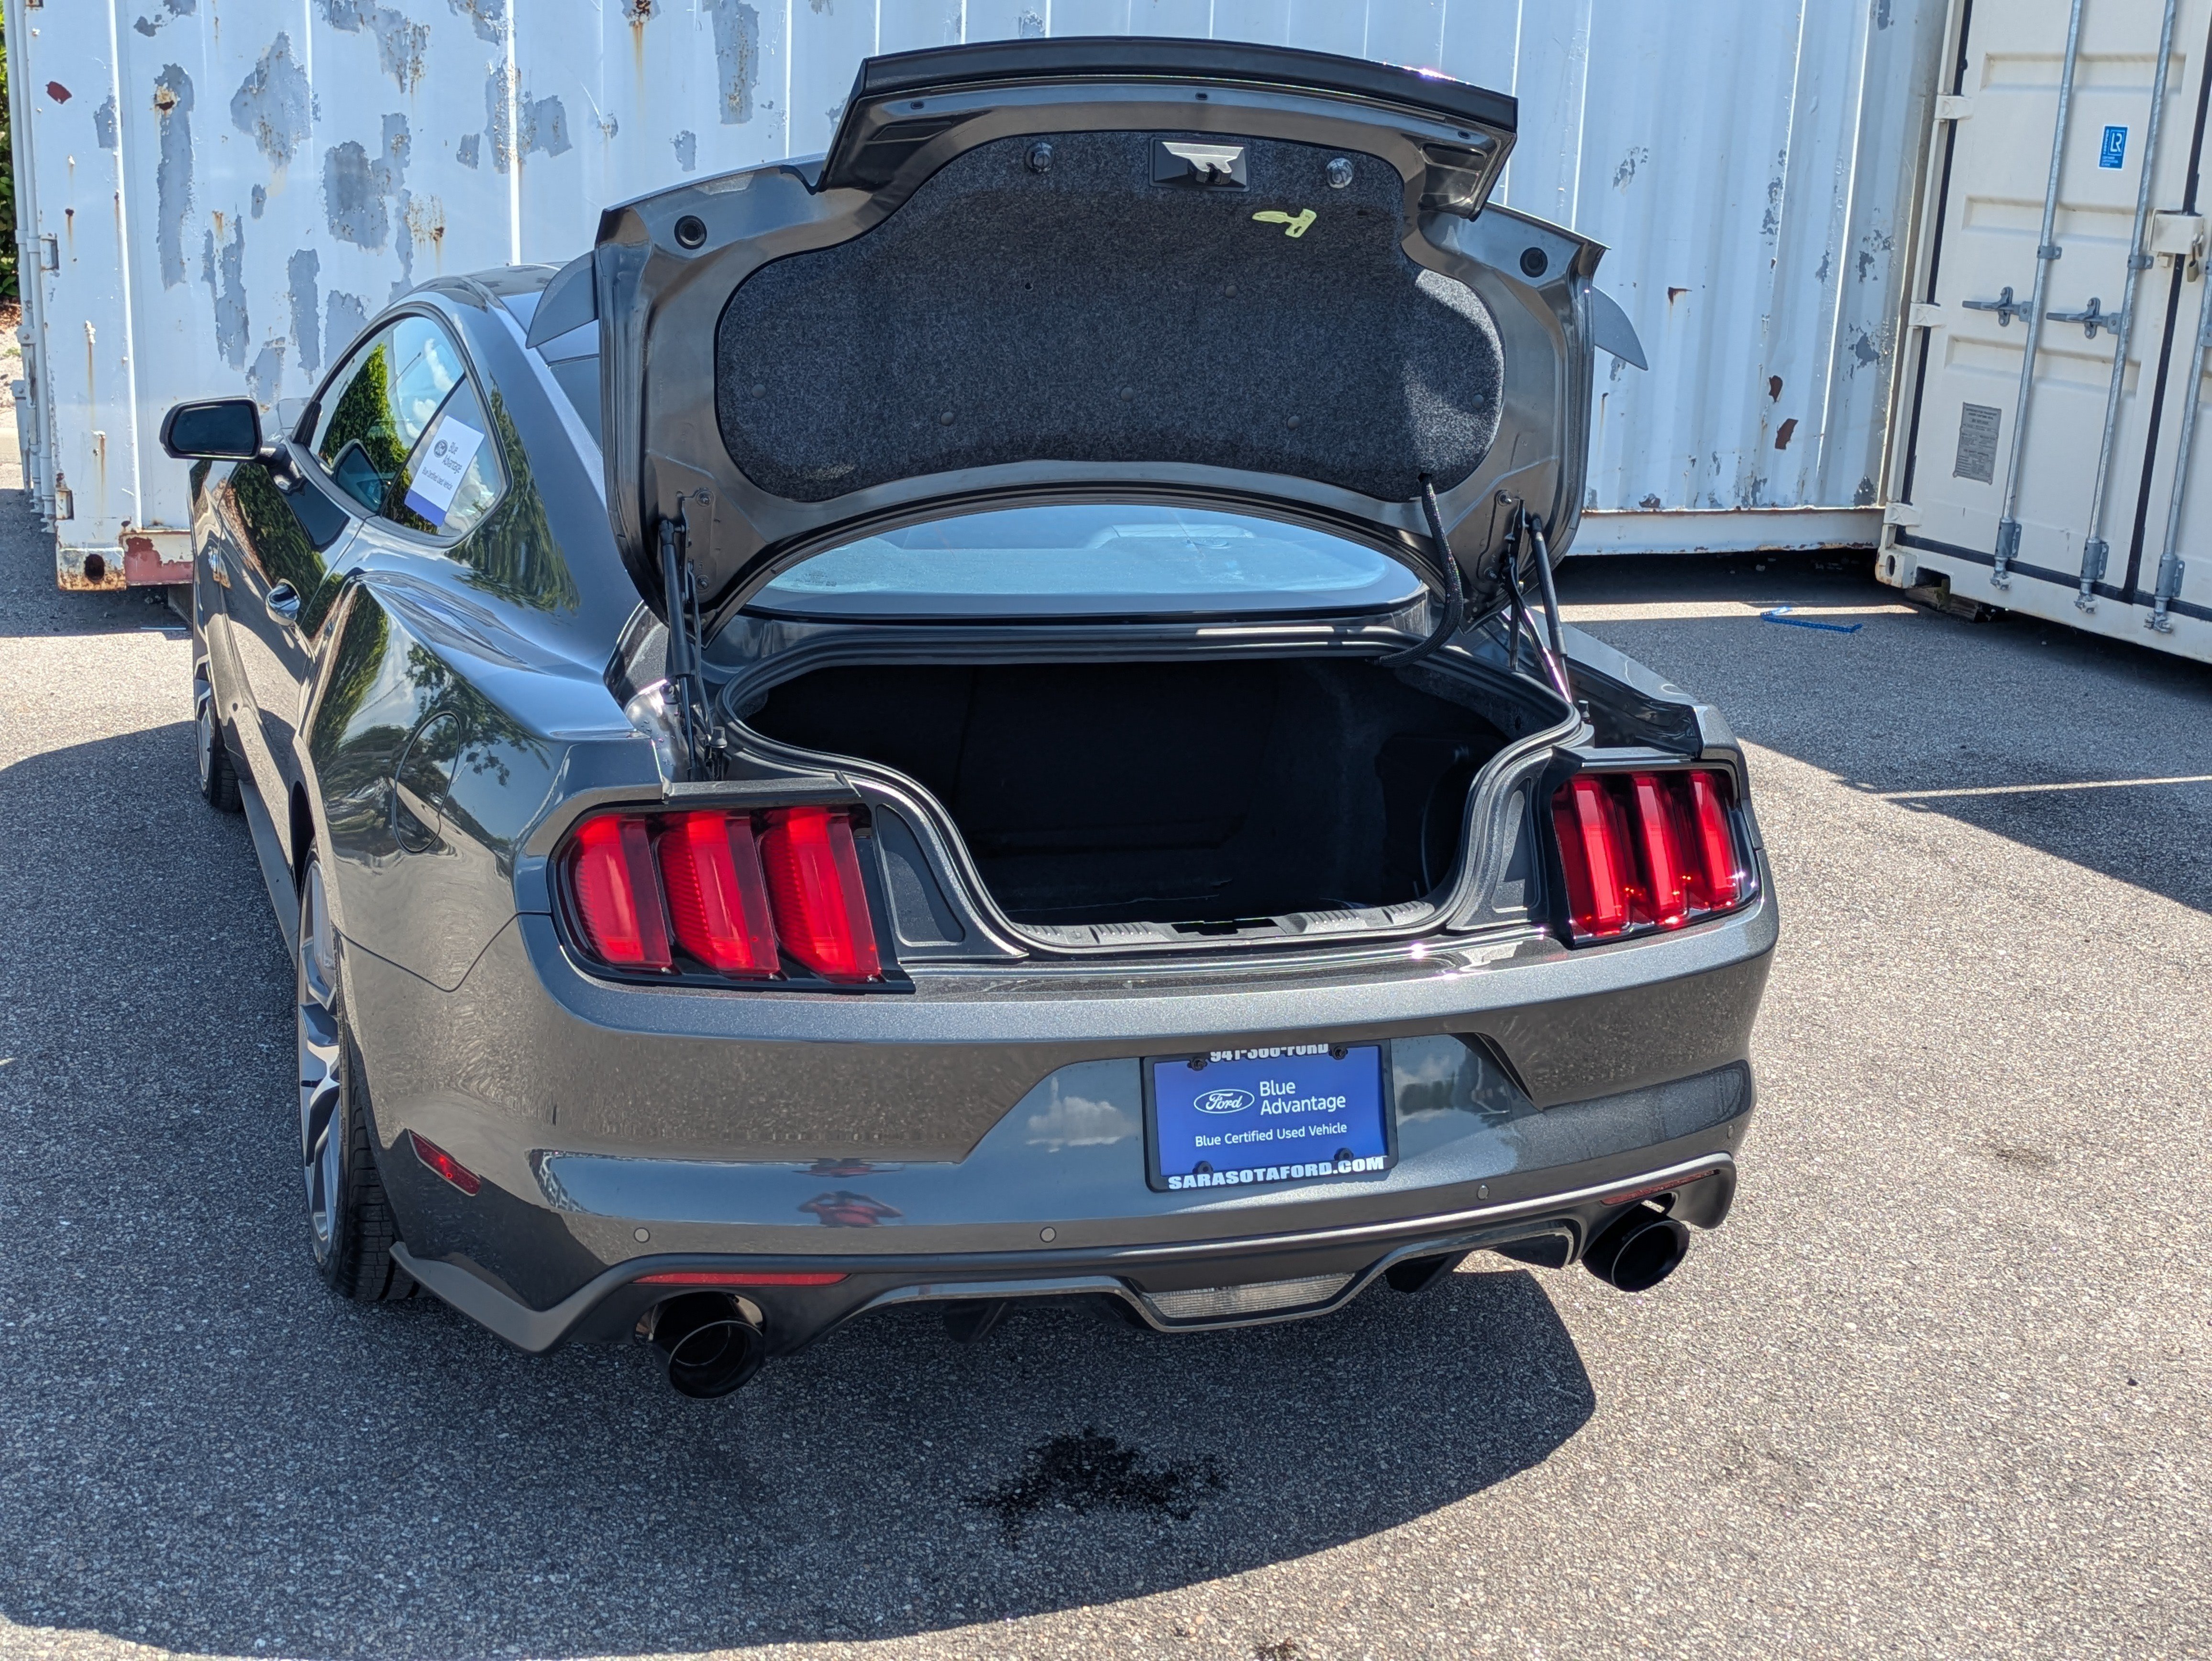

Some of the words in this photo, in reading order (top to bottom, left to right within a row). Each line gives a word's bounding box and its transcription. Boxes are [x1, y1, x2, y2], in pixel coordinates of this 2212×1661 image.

[1260, 1080, 1296, 1096] Blue
[1206, 1092, 1243, 1110] Ford
[1260, 1096, 1346, 1116] Advantage
[1195, 1135, 1221, 1147] Blue
[1225, 1129, 1273, 1144] Certified
[1276, 1126, 1305, 1140] Used
[1308, 1122, 1348, 1137] Vehicle
[1168, 1156, 1385, 1190] SARASOTAFORD.COM
